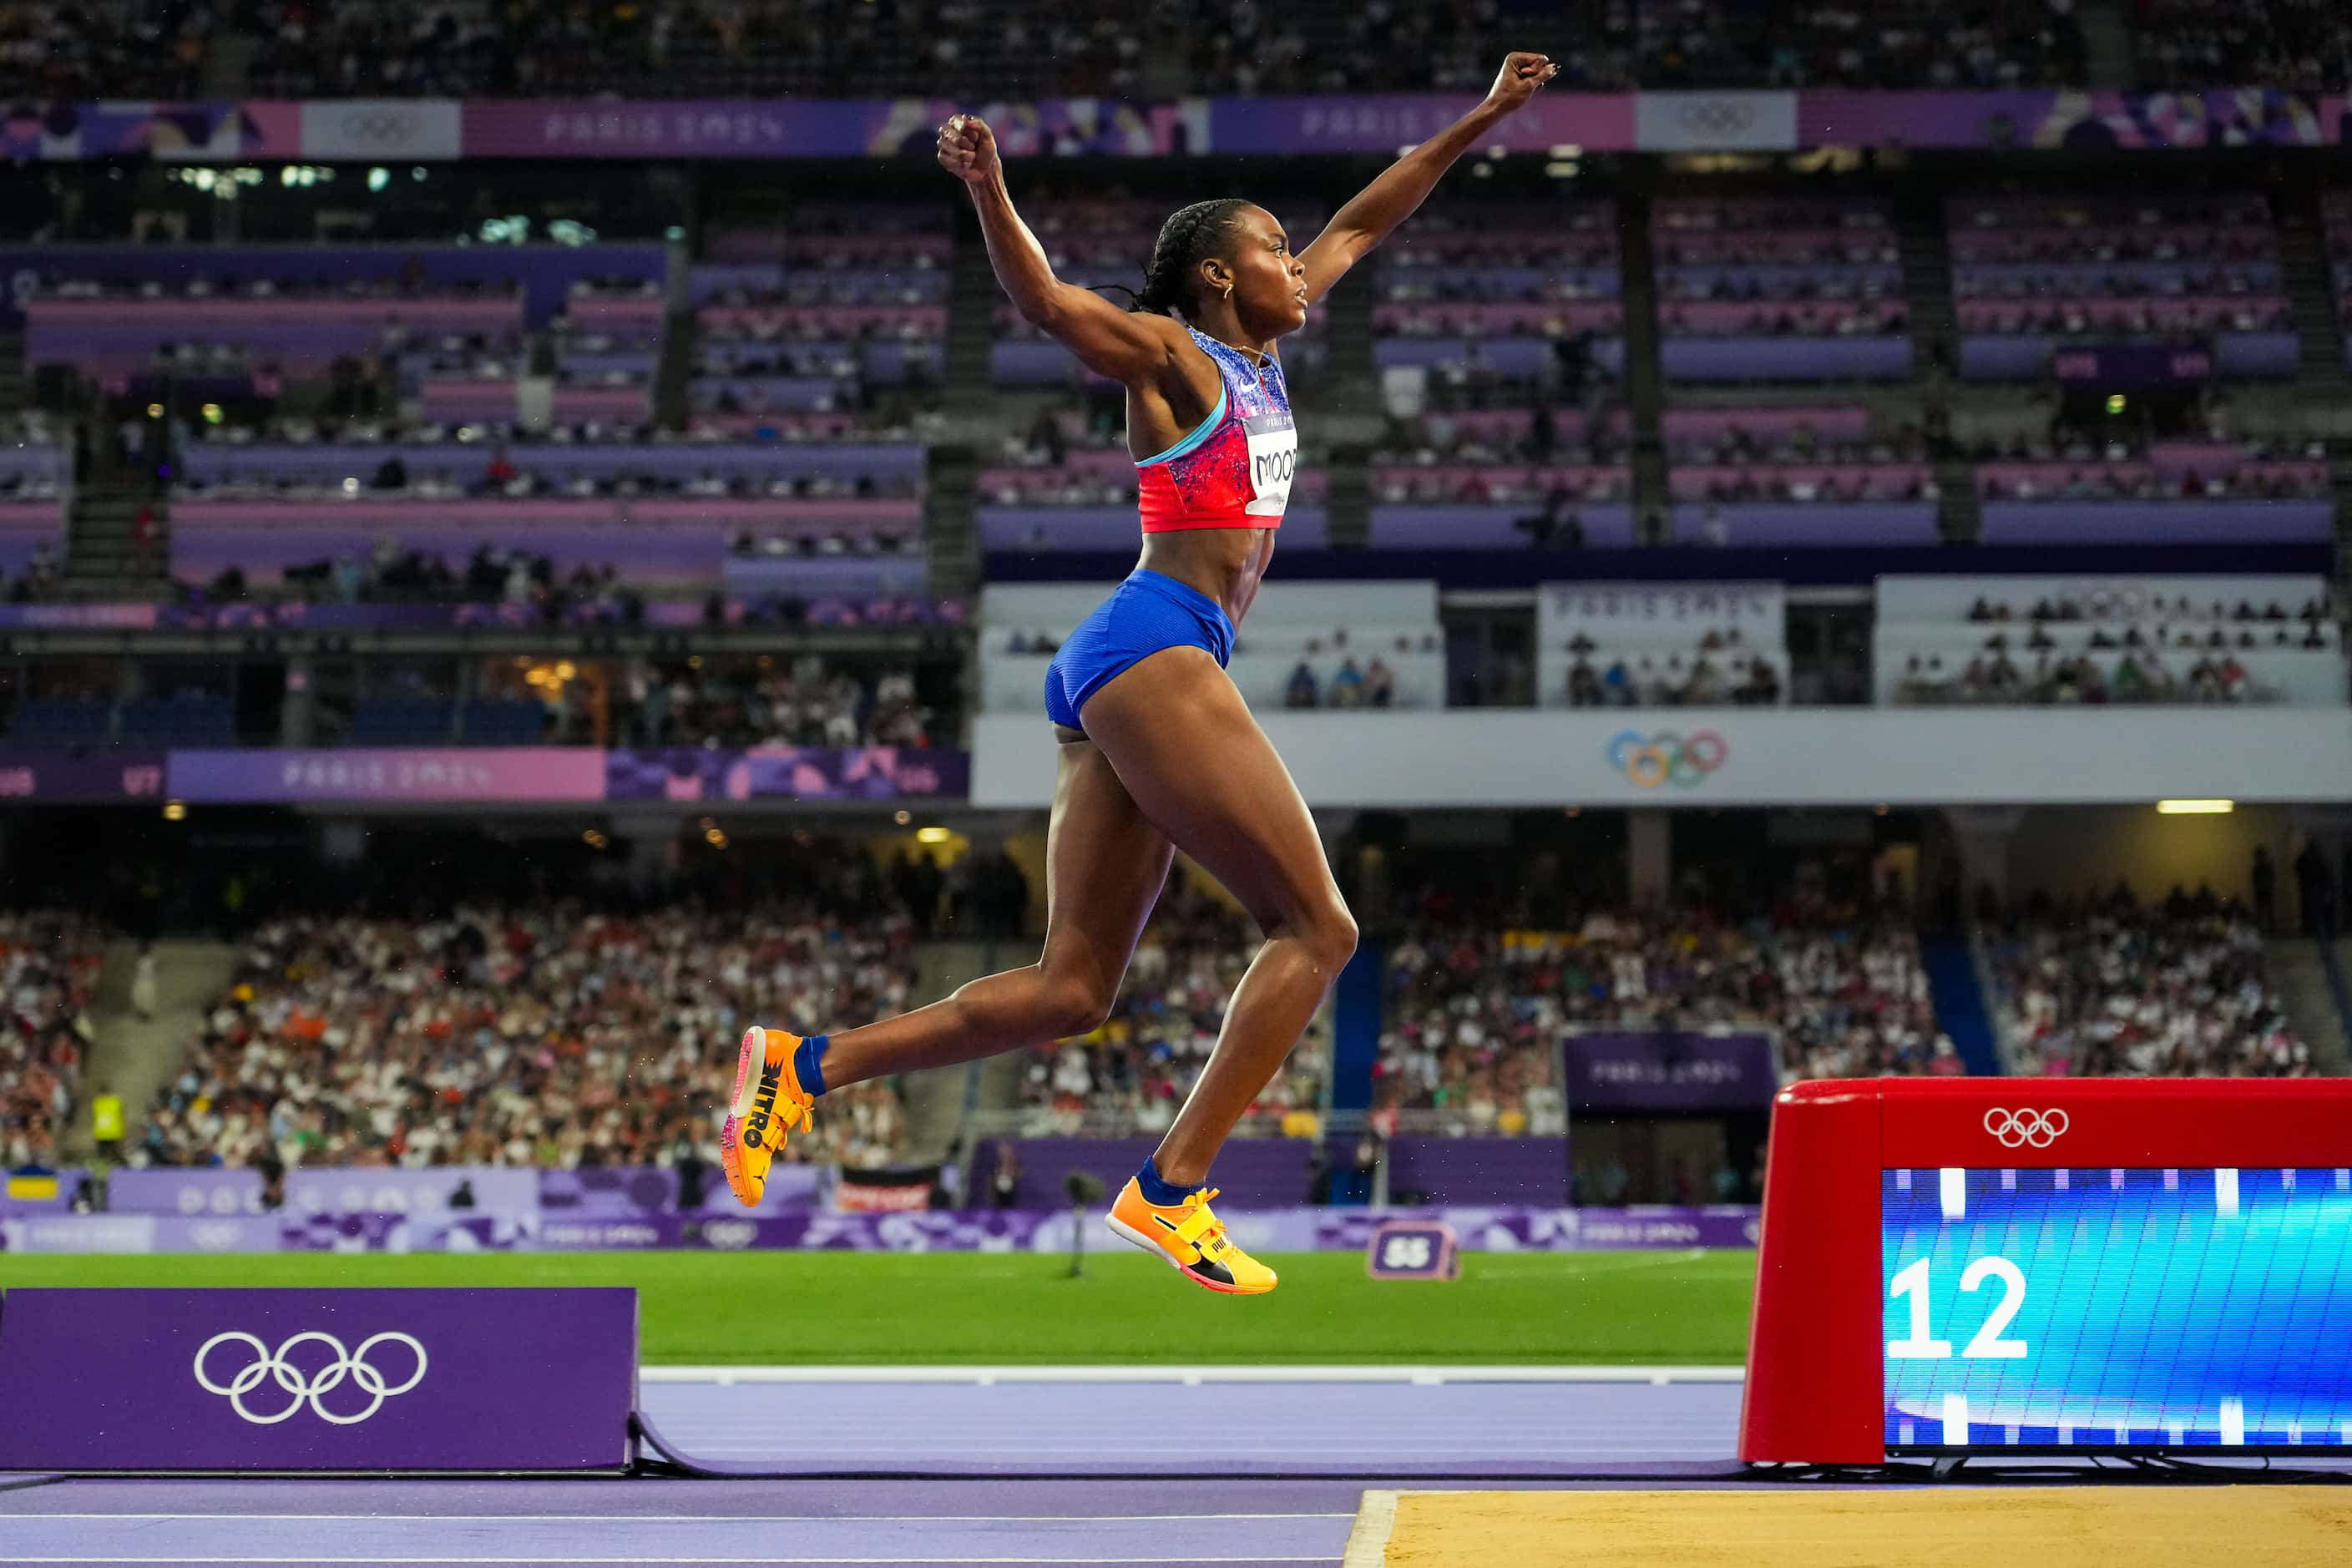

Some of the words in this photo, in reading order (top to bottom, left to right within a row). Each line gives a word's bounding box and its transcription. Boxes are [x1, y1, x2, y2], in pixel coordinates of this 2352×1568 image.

[546, 111, 662, 143] PARIS
[1301, 107, 1417, 137] PARIS
[1256, 448, 1297, 487] MOO
[1554, 589, 1660, 622] PARIS
[282, 758, 386, 790] PARIS
[743, 1058, 784, 1149] NITRO
[1211, 1237, 1227, 1253] PU
[1888, 1257, 2028, 1358] 12
